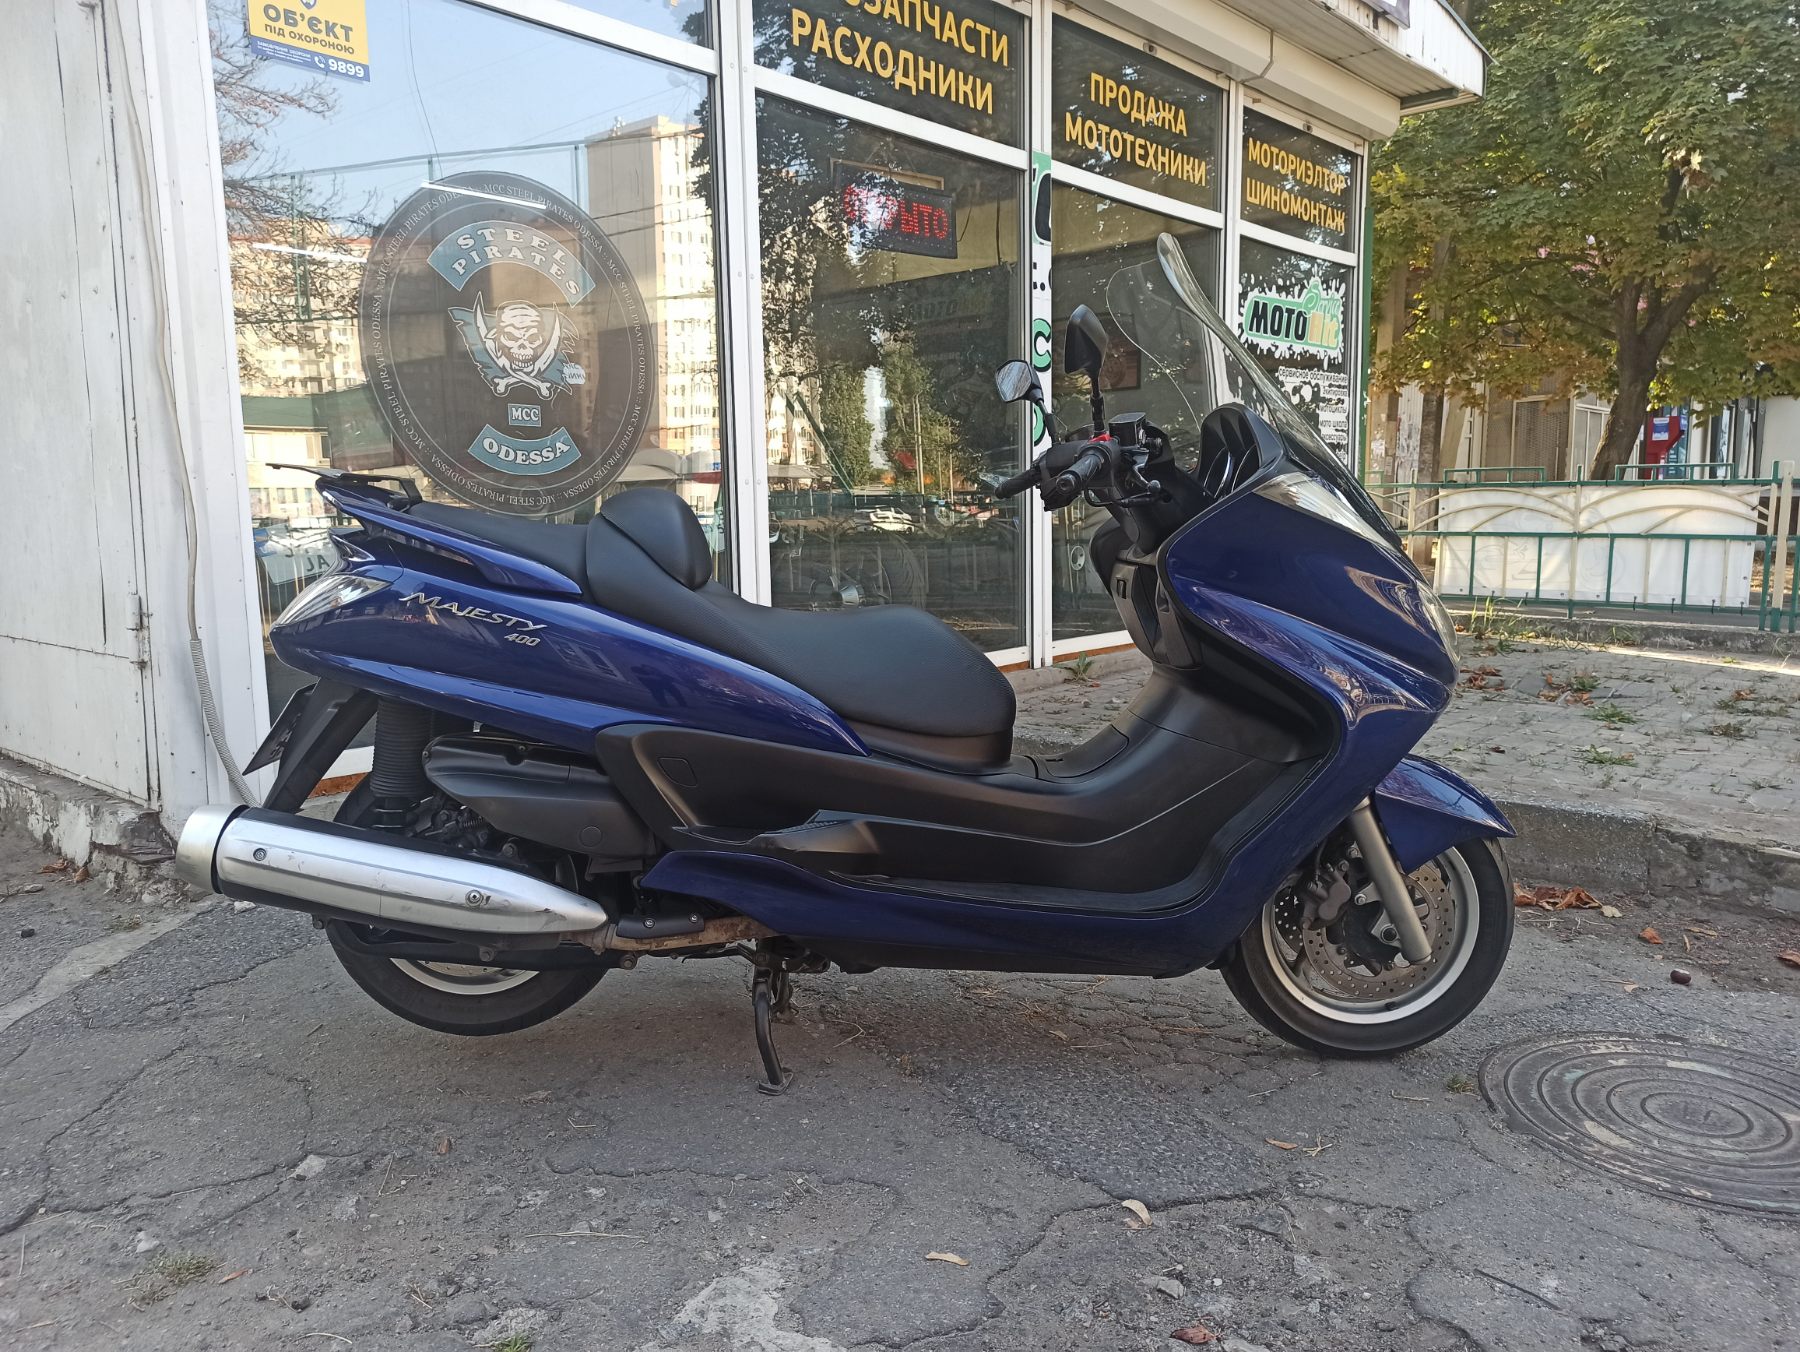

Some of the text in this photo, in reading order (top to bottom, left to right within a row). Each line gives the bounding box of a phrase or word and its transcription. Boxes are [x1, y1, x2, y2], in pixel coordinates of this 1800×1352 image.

[264, 23, 285, 39] ПІД
[288, 30, 355, 55] ОХОРОНОЮ
[328, 58, 364, 78] 9899
[792, 8, 993, 115] РАСХОДНИКИ
[1090, 72, 1187, 137] ПРОДАЖА
[1065, 111, 1206, 187] МОТОТЕХНИКИ
[1248, 138, 1345, 197] МОТОРИЭЛТОР
[403, 198, 440, 231] PIRATES
[484, 184, 604, 253] MCC STEEL PIRATES ODESSA
[1246, 177, 1345, 235] ШИНОМОНТАЖ
[457, 228, 566, 265] STEEL
[452, 246, 581, 296] PIRATES
[372, 294, 426, 450] MCC STEEL PIRATES ODESSA
[1279, 367, 1309, 379] сервисное
[511, 408, 539, 422] MCC
[482, 437, 570, 465] ODESSA
[618, 425, 635, 453] STEEL
[431, 454, 465, 485] ODESSA
[593, 451, 620, 482] PIRATES
[465, 480, 505, 502] PIRATES
[563, 477, 594, 499] ODESSA
[398, 592, 548, 631] MAJESTY
[504, 633, 541, 647] 400
